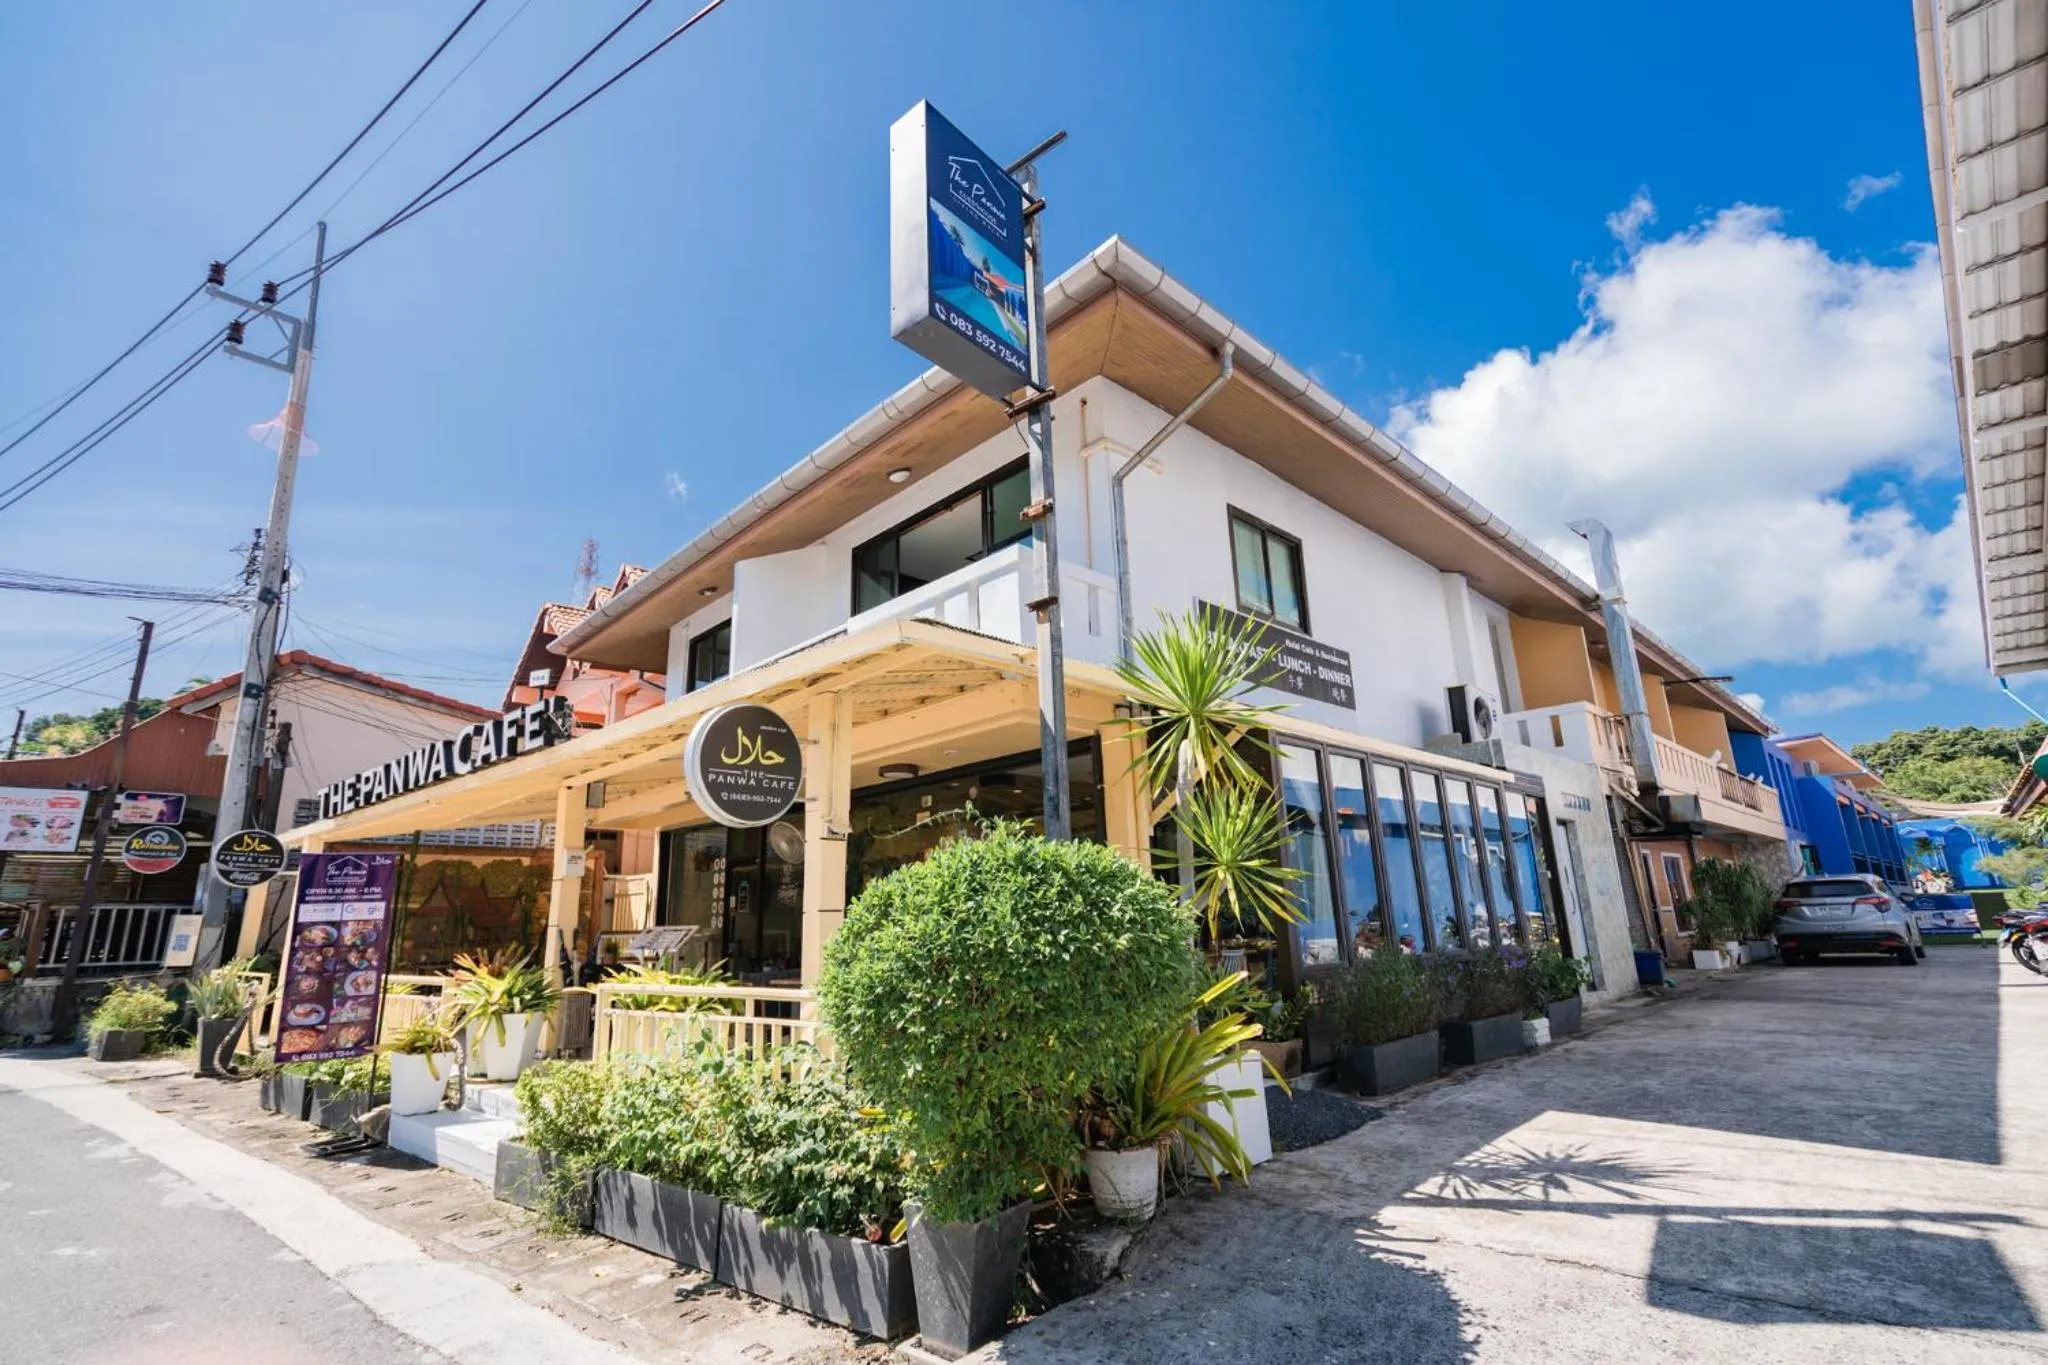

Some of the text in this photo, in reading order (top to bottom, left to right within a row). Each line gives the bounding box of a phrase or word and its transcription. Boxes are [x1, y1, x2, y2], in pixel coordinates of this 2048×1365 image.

[948, 161, 969, 188] The
[949, 313, 1026, 372] 083 592 7544
[1277, 653, 1312, 676] LUNCH
[1318, 666, 1352, 688] DINNER
[316, 699, 546, 819] THE PANWA CAFE
[721, 725, 785, 766] حلال
[708, 773, 796, 790] PANWA CAFE
[743, 769, 766, 779] THE
[233, 834, 272, 852] حلال
[219, 854, 281, 865] PANWA CAFE
